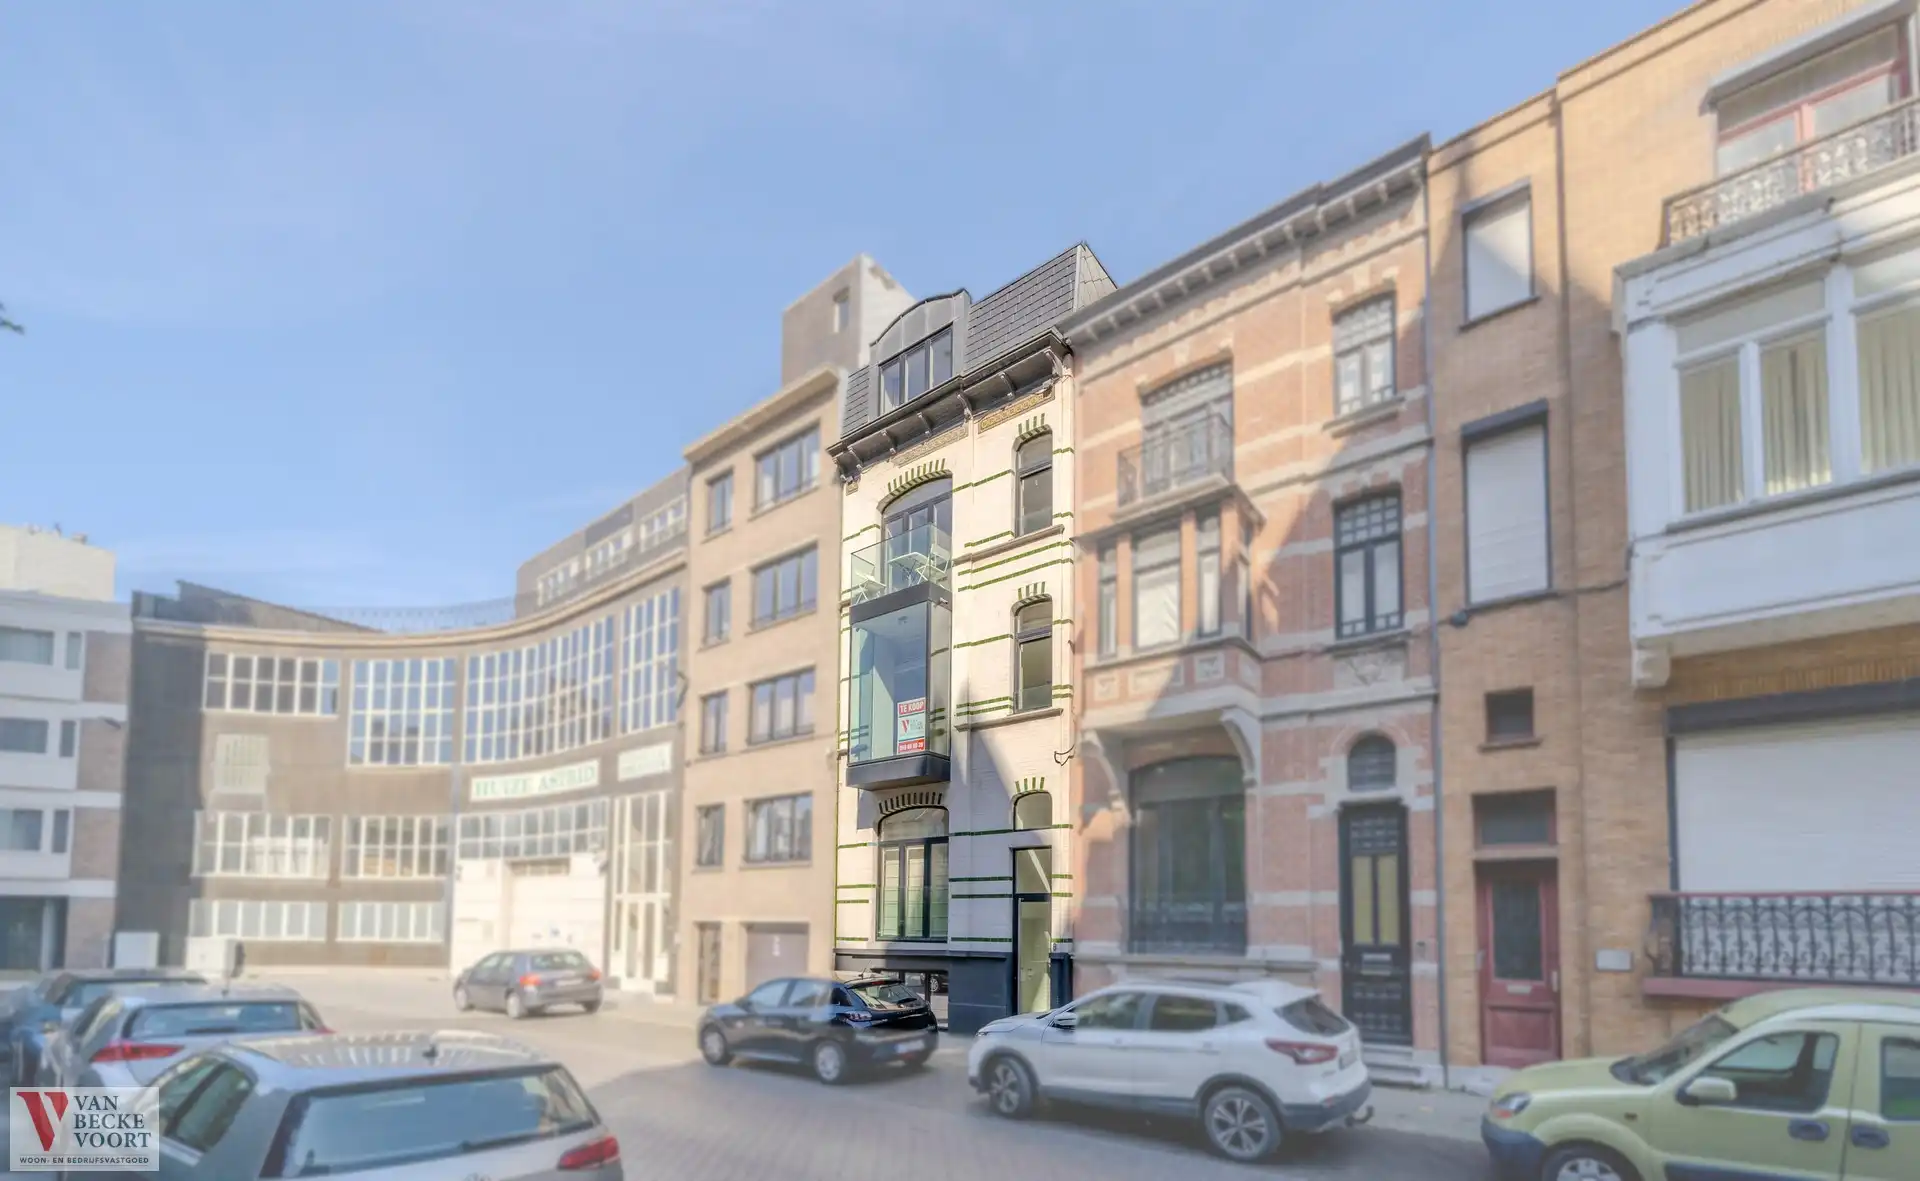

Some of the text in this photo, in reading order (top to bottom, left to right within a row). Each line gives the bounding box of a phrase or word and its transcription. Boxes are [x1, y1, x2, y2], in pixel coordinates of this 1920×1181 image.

[900, 701, 924, 713] TE KOOP
[538, 765, 595, 789] ASTRID
